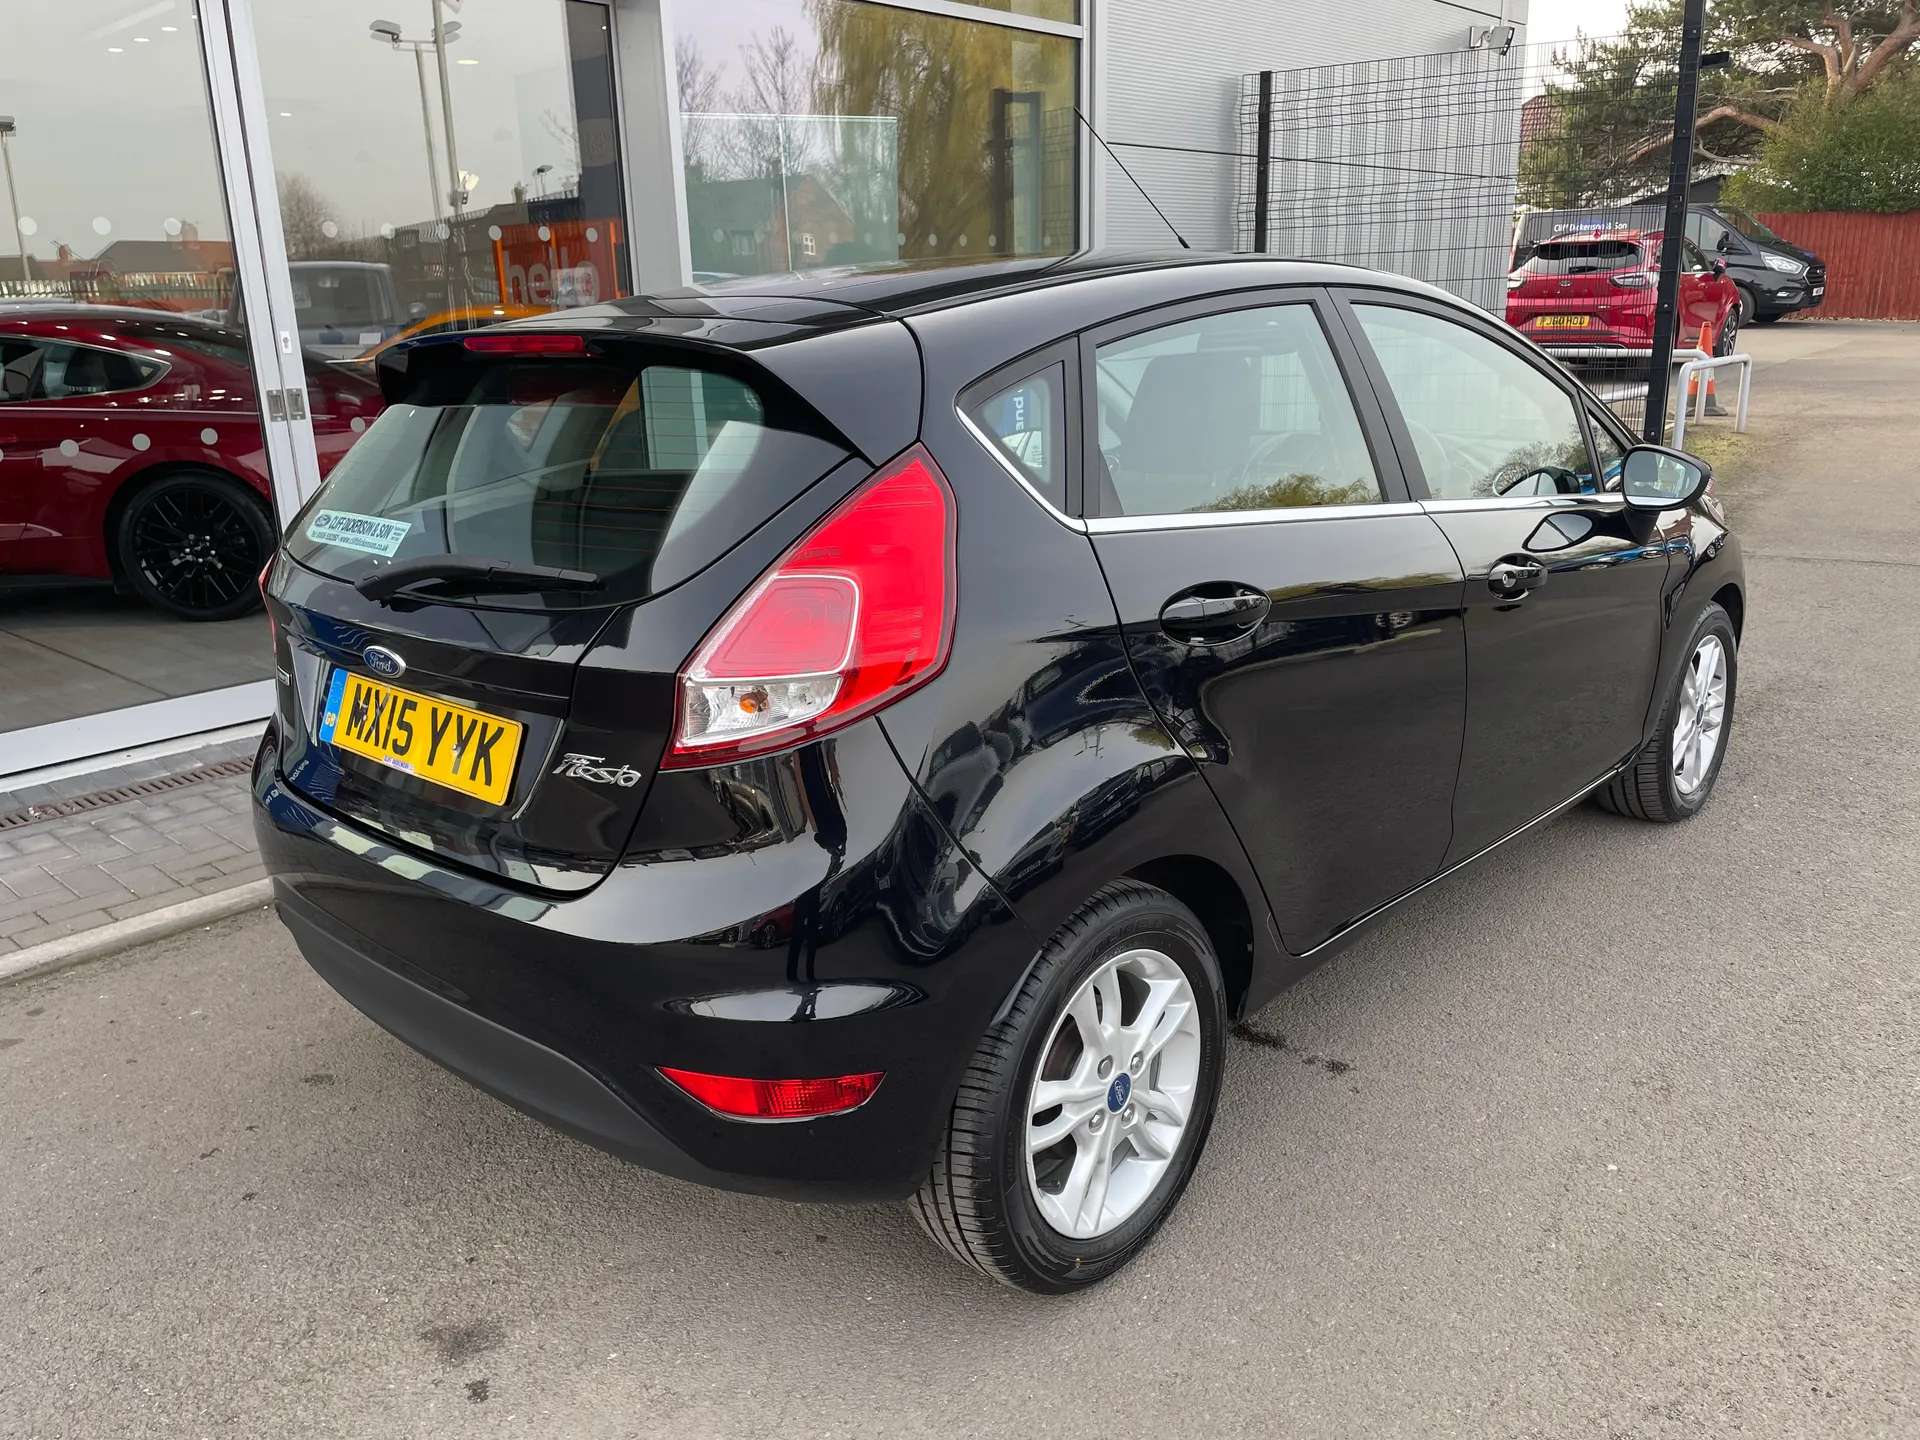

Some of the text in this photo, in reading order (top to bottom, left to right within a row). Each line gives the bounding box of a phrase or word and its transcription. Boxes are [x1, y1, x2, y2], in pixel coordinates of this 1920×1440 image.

[368, 653, 394, 673] Ford
[345, 683, 505, 787] MX15 YYK
[552, 752, 642, 788] Fiesta
